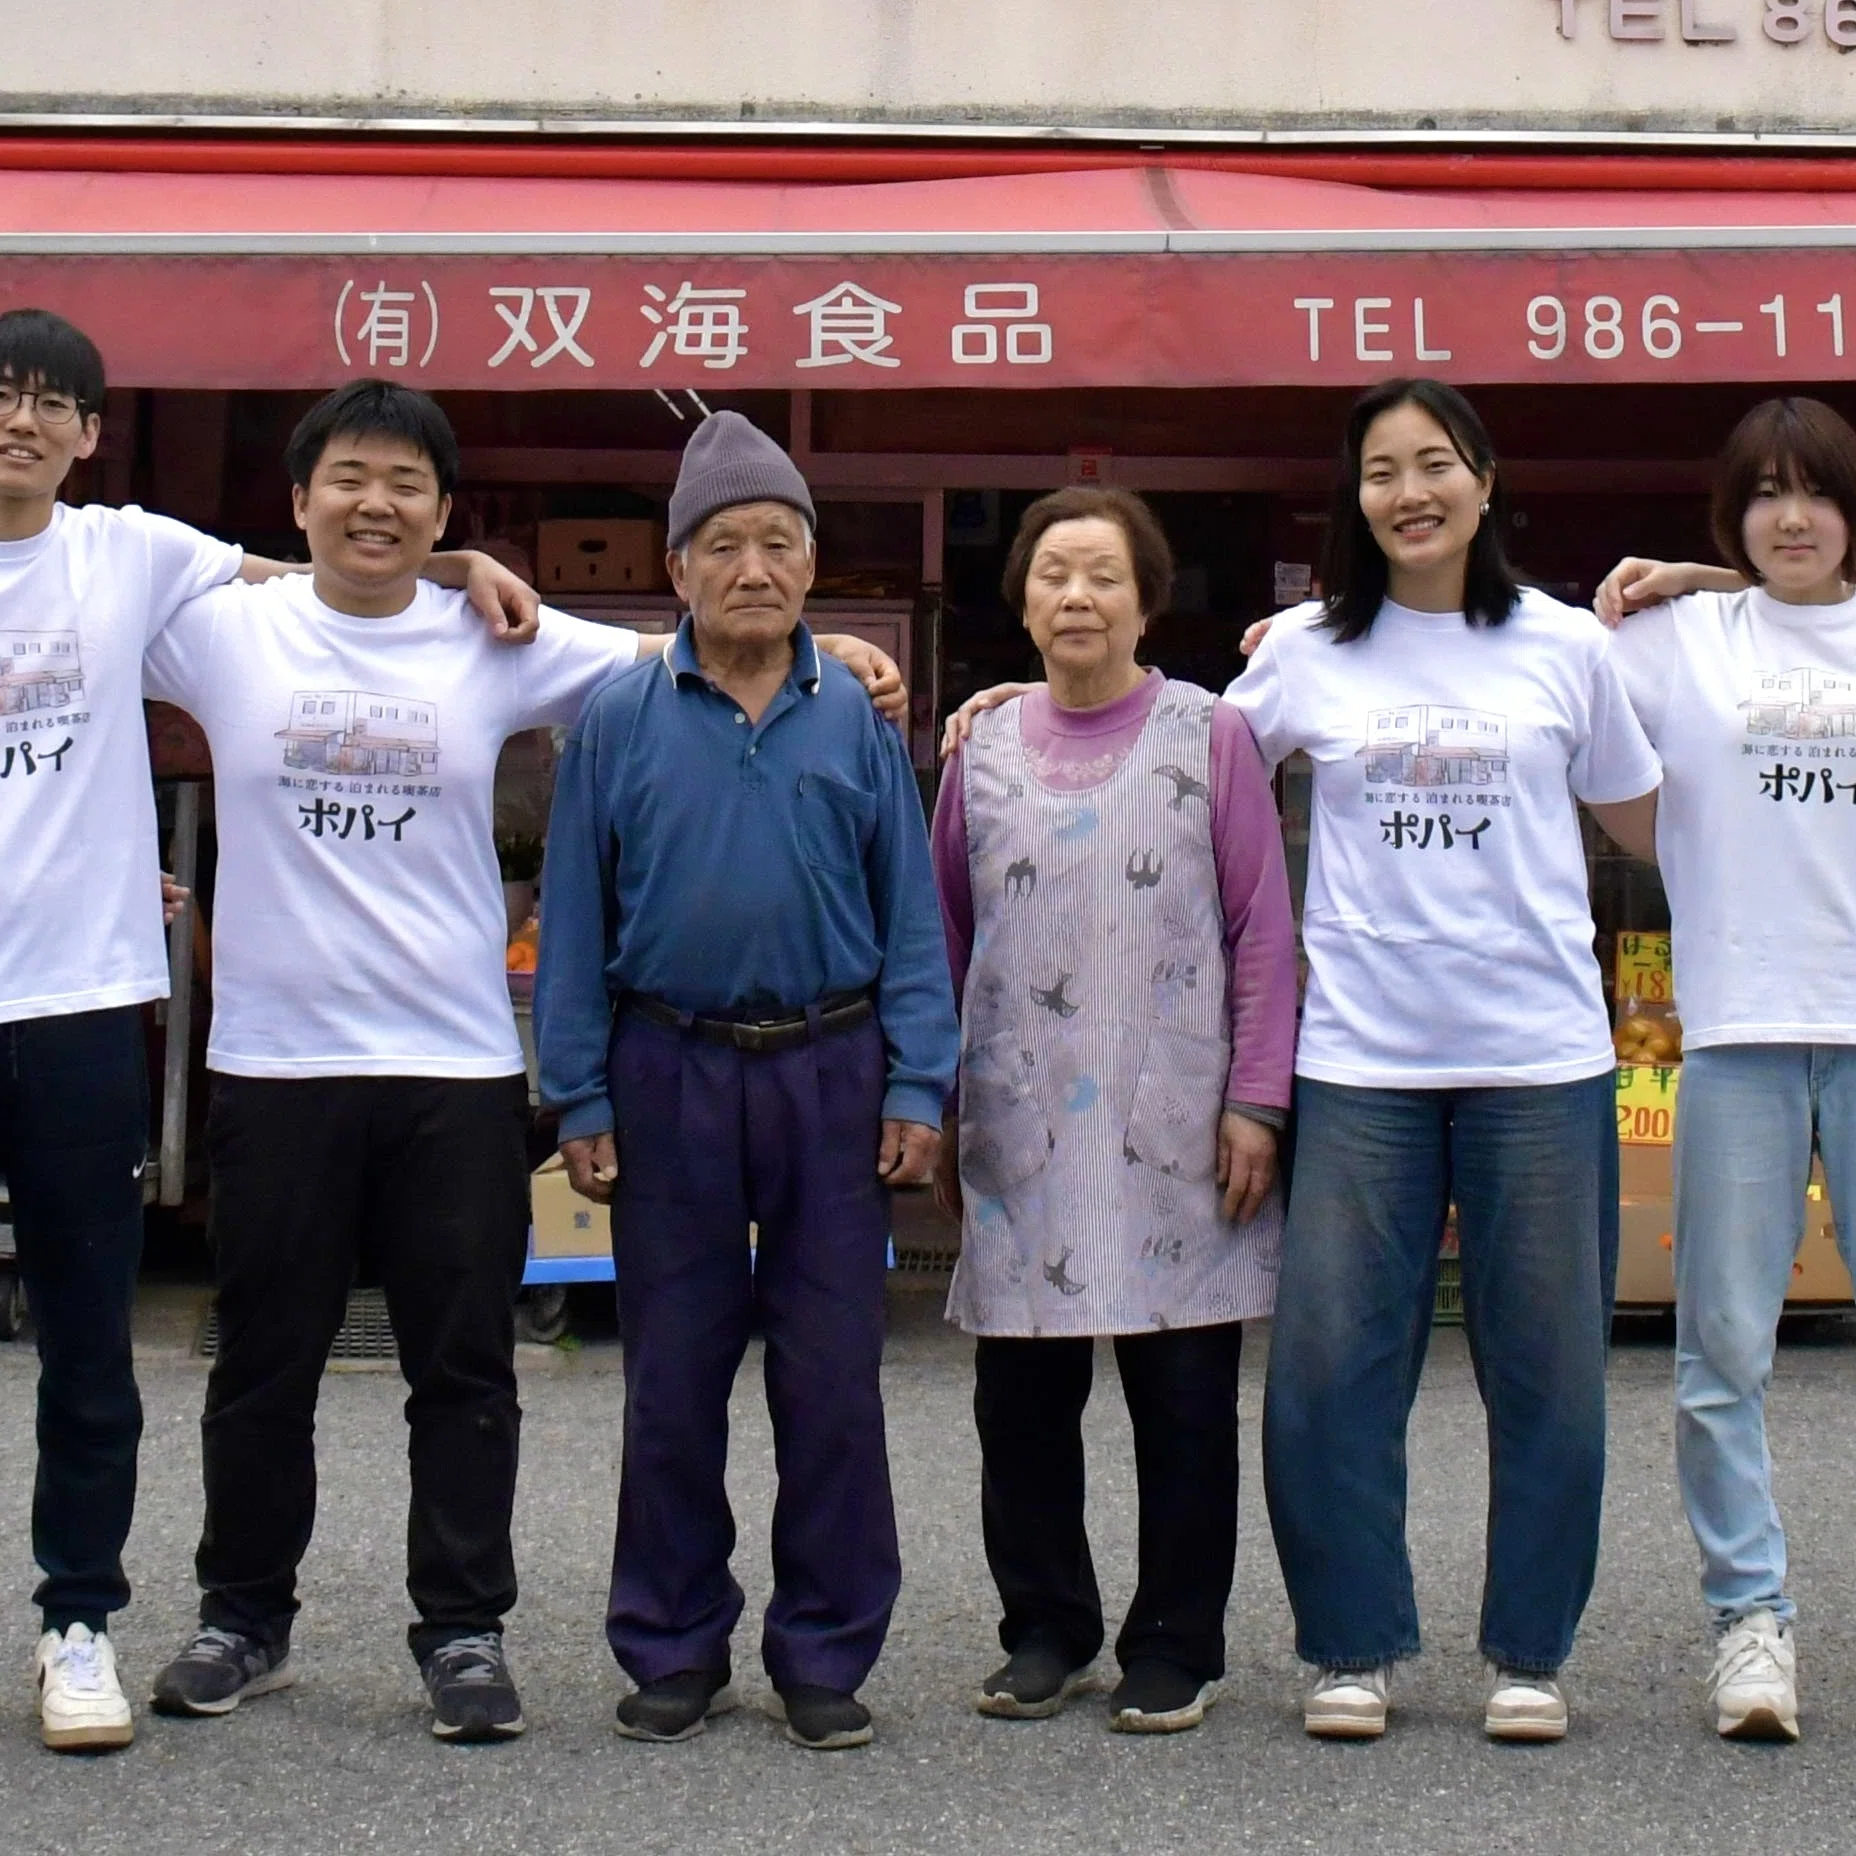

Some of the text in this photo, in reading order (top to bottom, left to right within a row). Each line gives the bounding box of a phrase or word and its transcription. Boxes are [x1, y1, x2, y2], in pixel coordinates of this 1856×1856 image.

[1294, 297, 1451, 361] TEL
[298, 798, 416, 842] ポパイ
[1380, 811, 1492, 850] ポパイ
